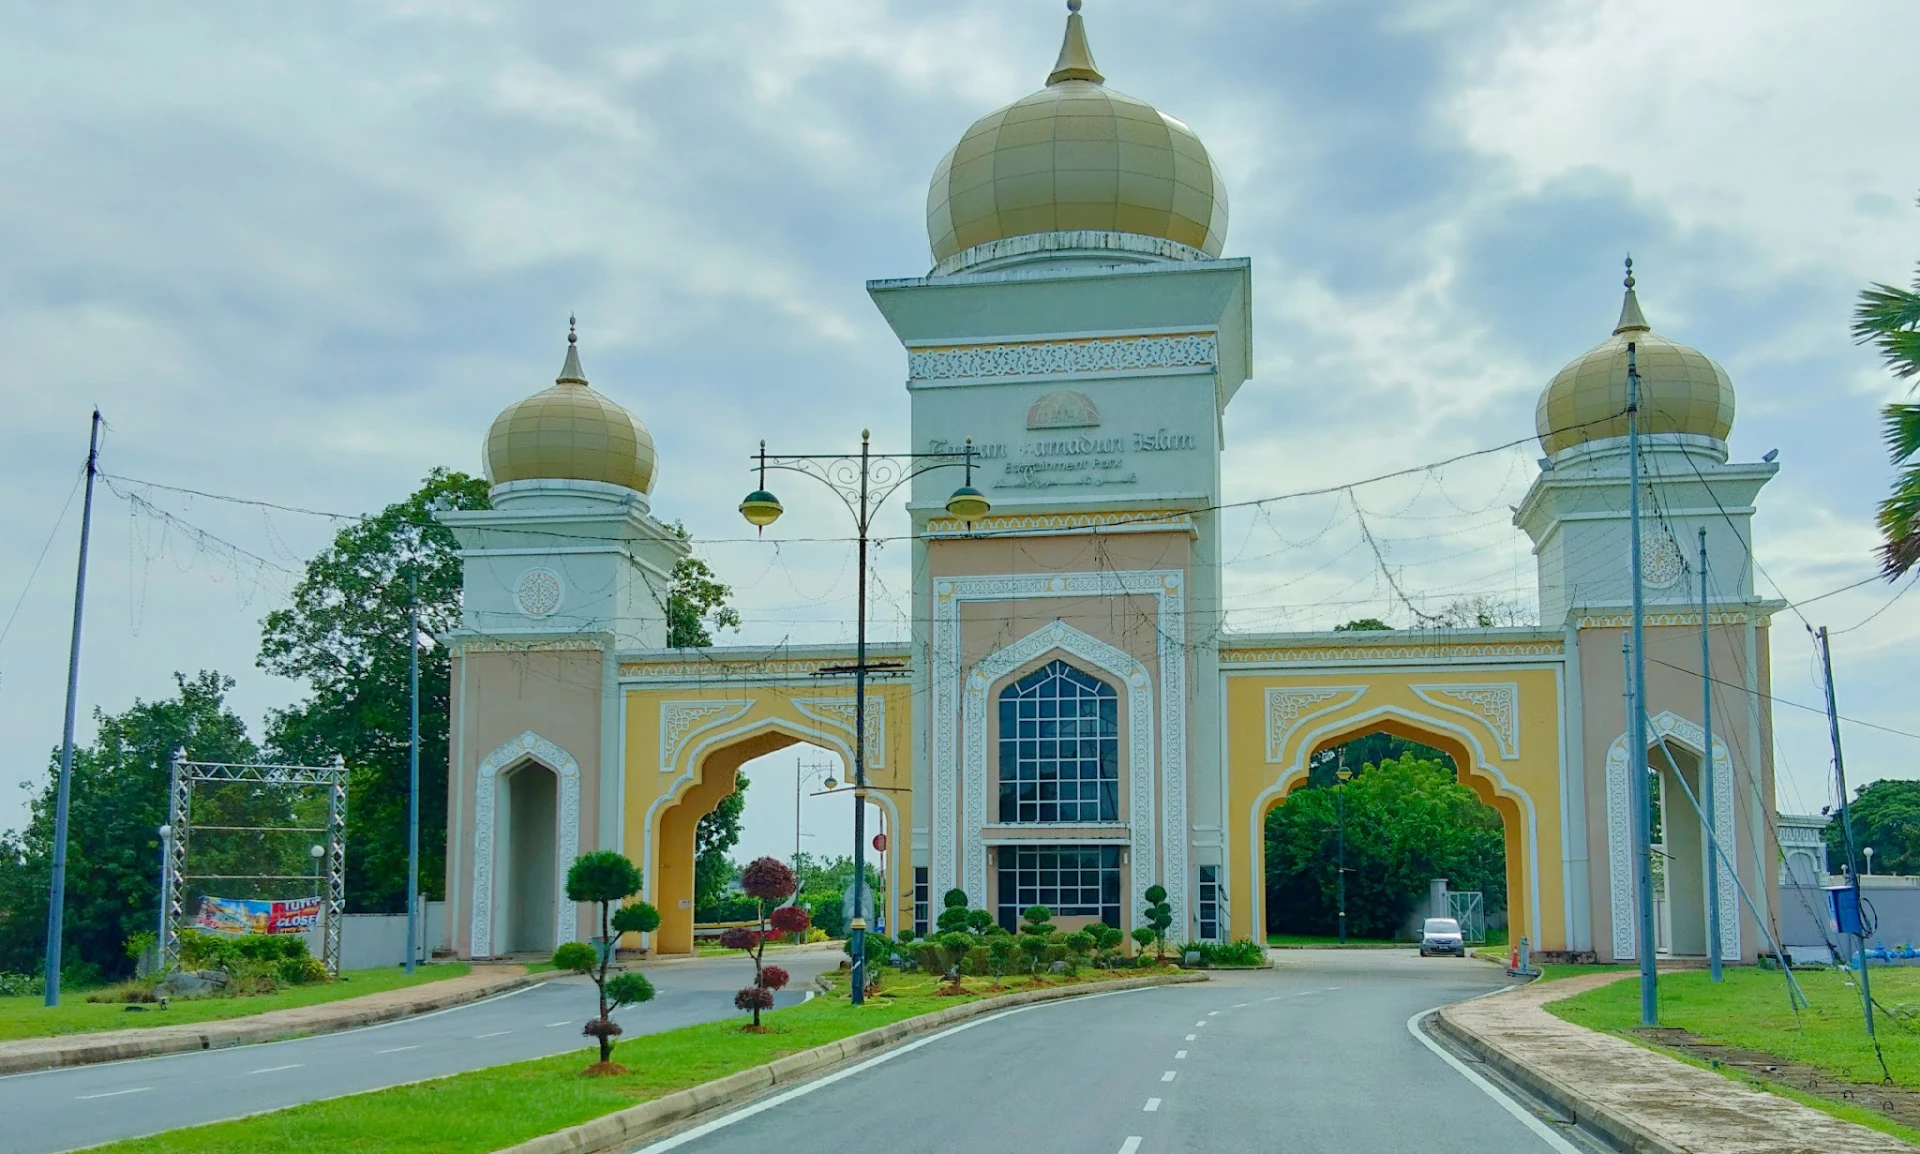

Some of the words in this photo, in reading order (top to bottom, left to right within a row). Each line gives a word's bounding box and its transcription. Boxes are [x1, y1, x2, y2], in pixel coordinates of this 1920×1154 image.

[1020, 432, 1123, 457] amadun
[1133, 428, 1196, 453] Islam
[1092, 458, 1122, 469] Park
